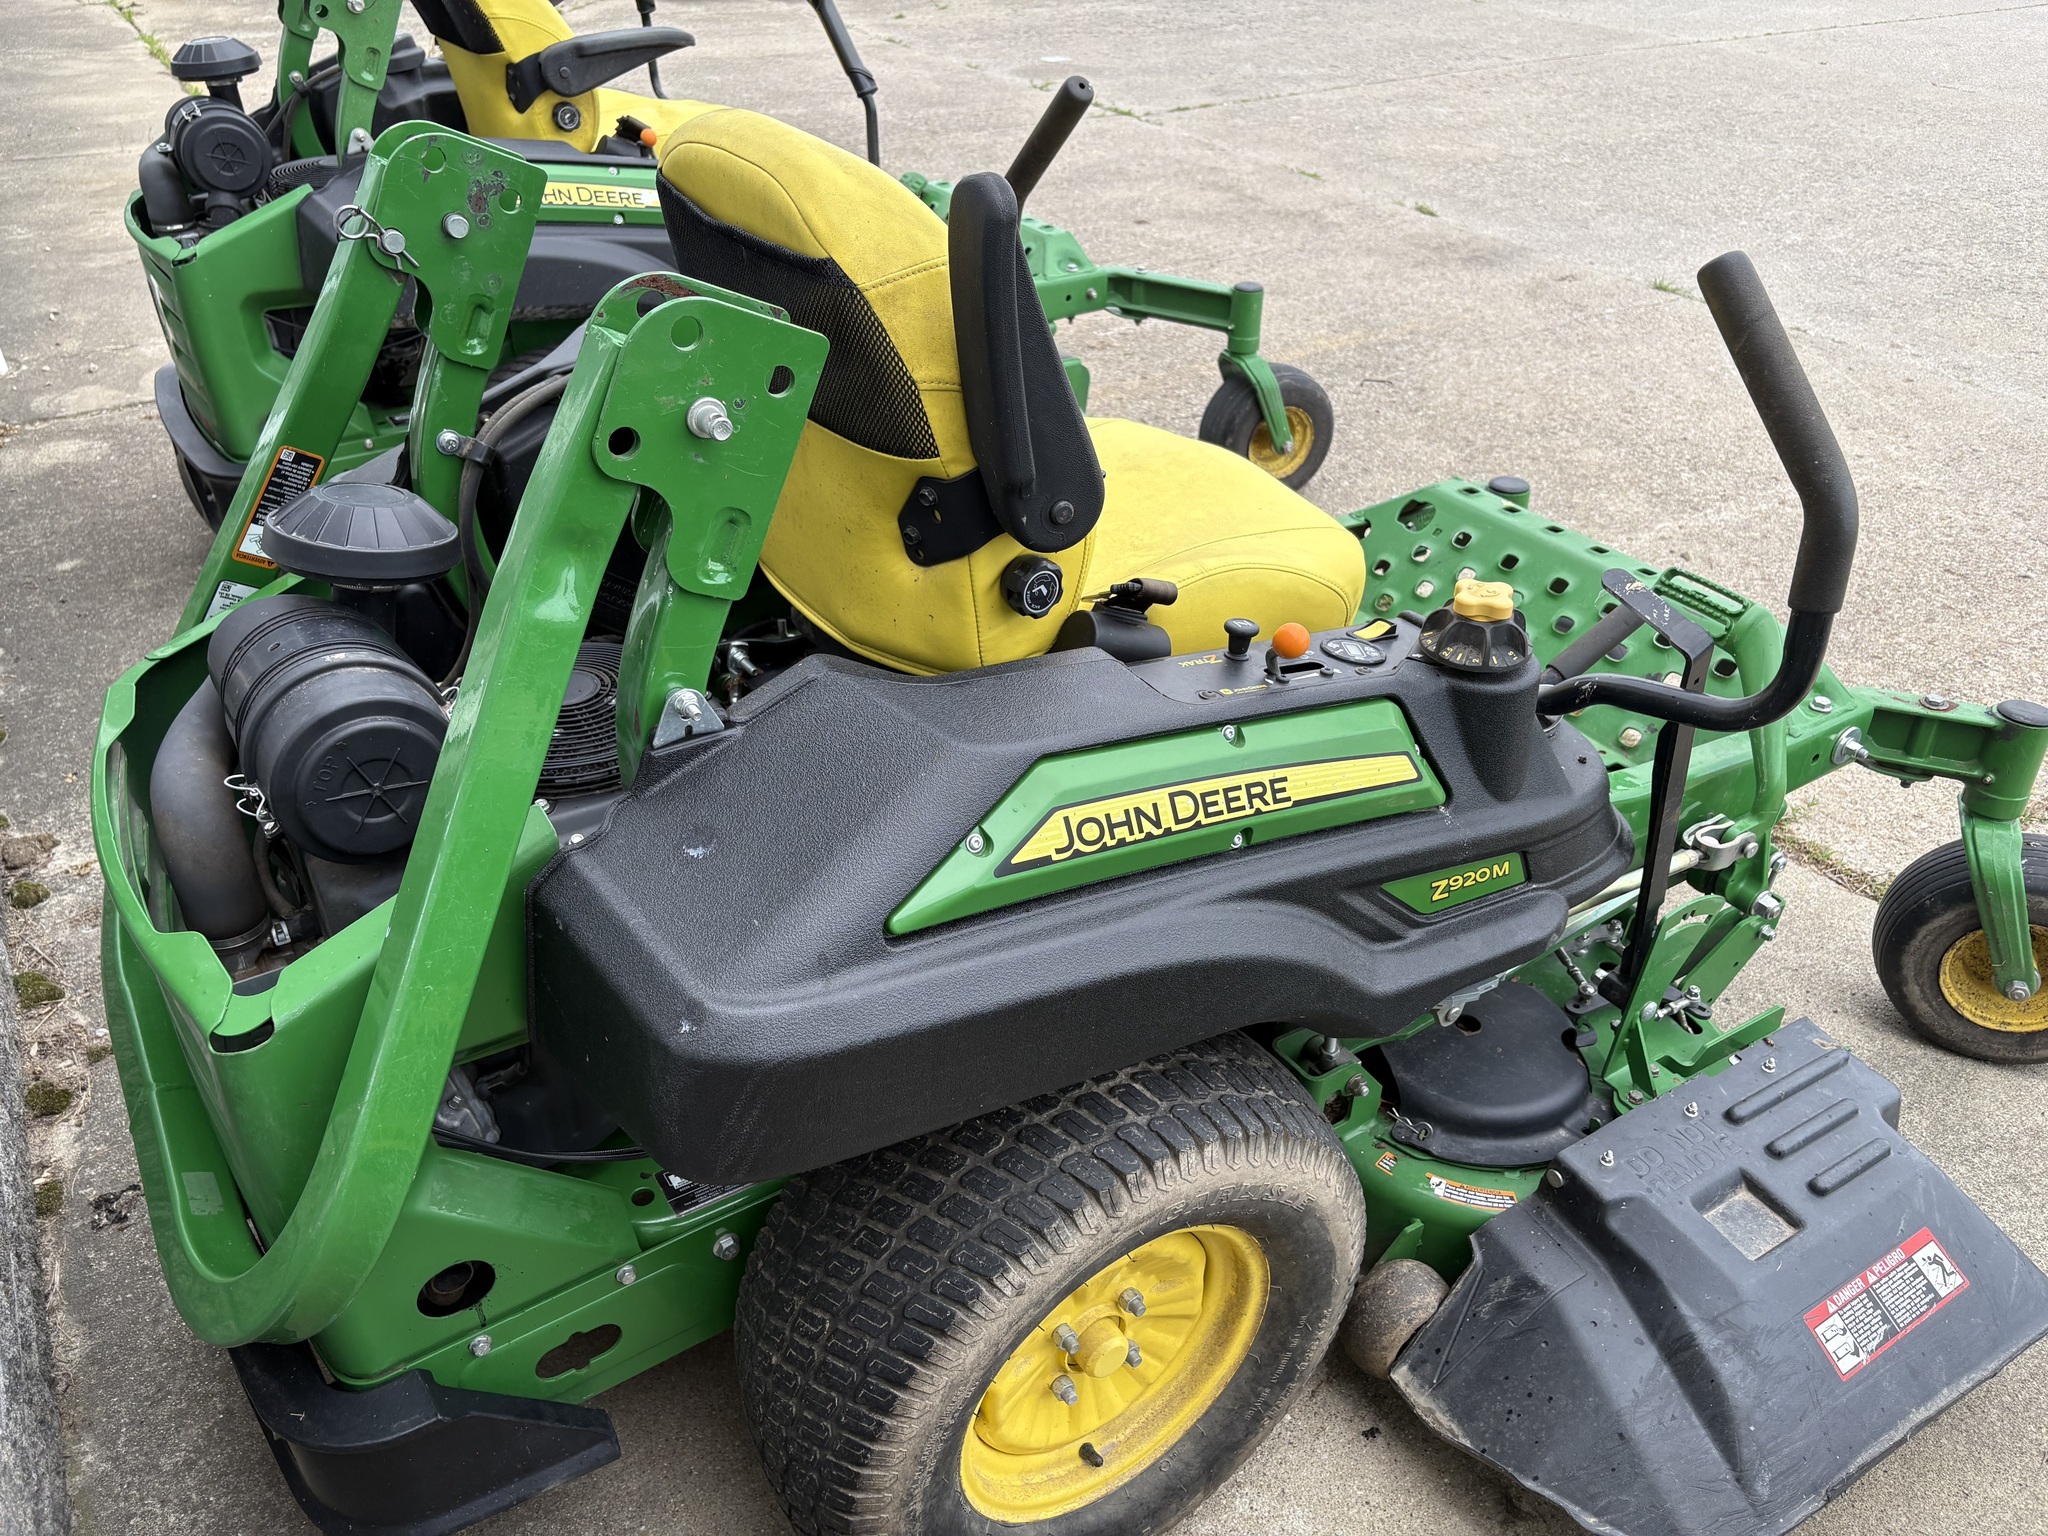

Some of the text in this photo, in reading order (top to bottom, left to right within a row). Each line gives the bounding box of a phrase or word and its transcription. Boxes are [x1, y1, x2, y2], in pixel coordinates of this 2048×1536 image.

[576, 186, 645, 206] DEERE
[1176, 653, 1223, 668] ZTRAK
[1441, 646, 1453, 657] 2.5
[309, 756, 339, 791] TOP
[1054, 776, 1292, 855] JOHN DEERE
[1431, 861, 1509, 901] Z920M
[1622, 1113, 1716, 1179] DO NOT
[1647, 1133, 1743, 1198] REMOVE
[1158, 1180, 1316, 1225] CARLISLE
[1832, 1278, 1866, 1306] DANGER
[1872, 1248, 1906, 1277] PELIGRO
[1288, 1333, 1300, 1348] FOR
[1269, 1351, 1292, 1384] HIGHWAY
[1243, 1387, 1270, 1421] SERVICE
